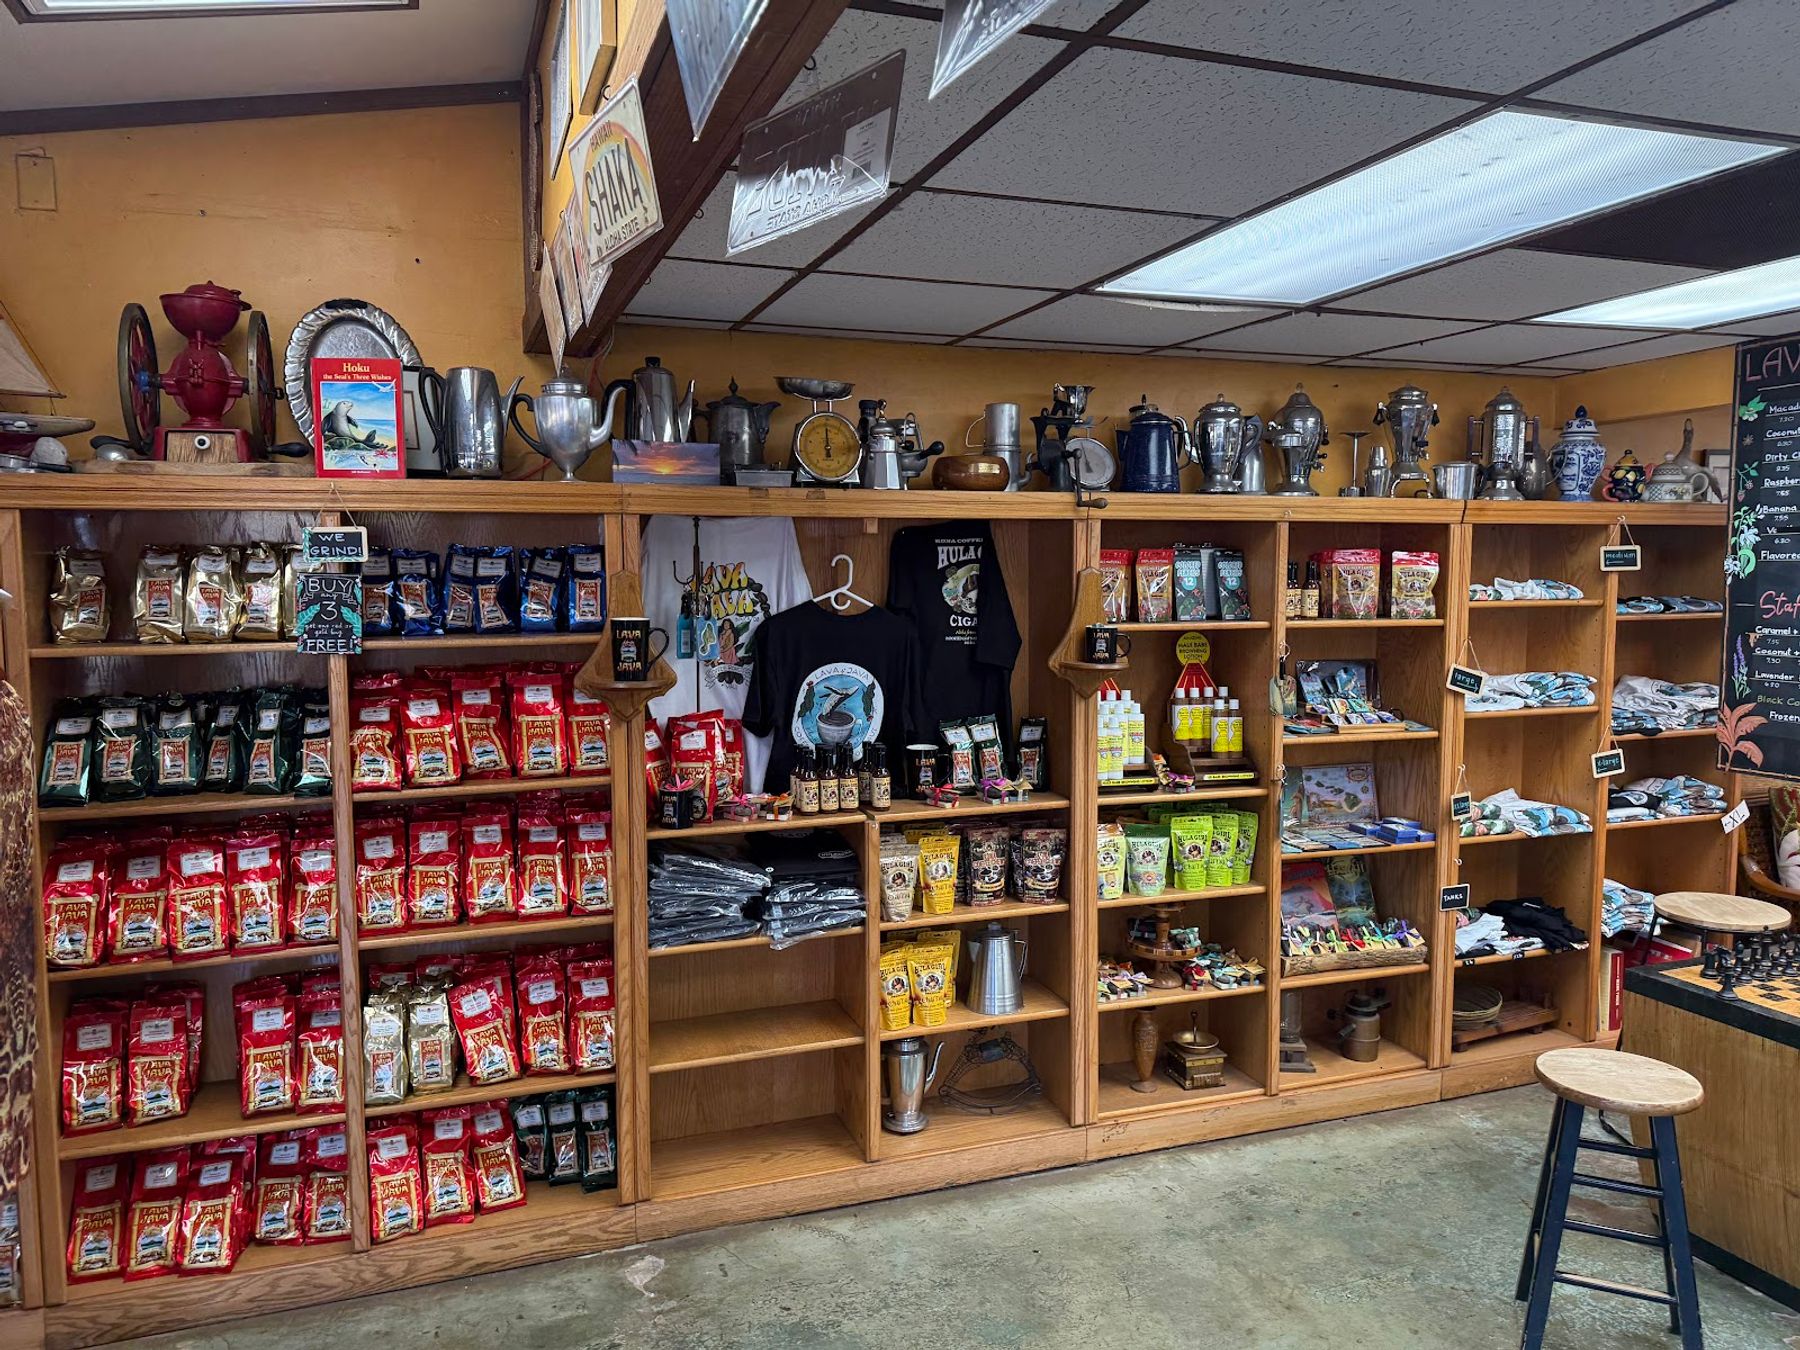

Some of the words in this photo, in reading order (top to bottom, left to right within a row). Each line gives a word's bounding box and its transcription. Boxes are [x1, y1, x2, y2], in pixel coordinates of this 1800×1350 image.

[585, 138, 643, 236] SHAKA
[604, 230, 623, 251] ALOHA
[622, 217, 640, 239] STATE
[343, 363, 370, 372] Hoku
[1765, 453, 1788, 462] Dirty
[1763, 505, 1797, 513] Banana
[310, 546, 362, 556] GRIND!
[937, 546, 976, 570] HULA
[308, 578, 354, 592] BUY
[1184, 577, 1194, 585] 12
[320, 602, 338, 620] 3
[616, 630, 641, 638] LAVA
[1756, 626, 1791, 634] Caramel
[306, 639, 354, 652] FREE!
[1755, 648, 1792, 656] Coconut
[618, 662, 642, 671] JAVA
[815, 666, 840, 680] LAVA
[847, 666, 870, 680] JAVA
[1755, 670, 1794, 680] Lavender
[1455, 672, 1474, 686] large
[1758, 695, 1784, 704] Black
[528, 727, 554, 735] JAVA
[478, 868, 503, 877] JAVA
[1444, 894, 1463, 902] TANKS
[60, 902, 87, 911] LAVA
[126, 902, 156, 911] JAVA
[58, 910, 88, 920] JAVA
[258, 1051, 282, 1059] LAVA
[483, 1150, 504, 1158] LAVA
[483, 1156, 507, 1166] JAVA
[143, 1206, 168, 1215] LAVA
[85, 1218, 113, 1228] JAVA
[140, 1214, 169, 1223] JAVA
